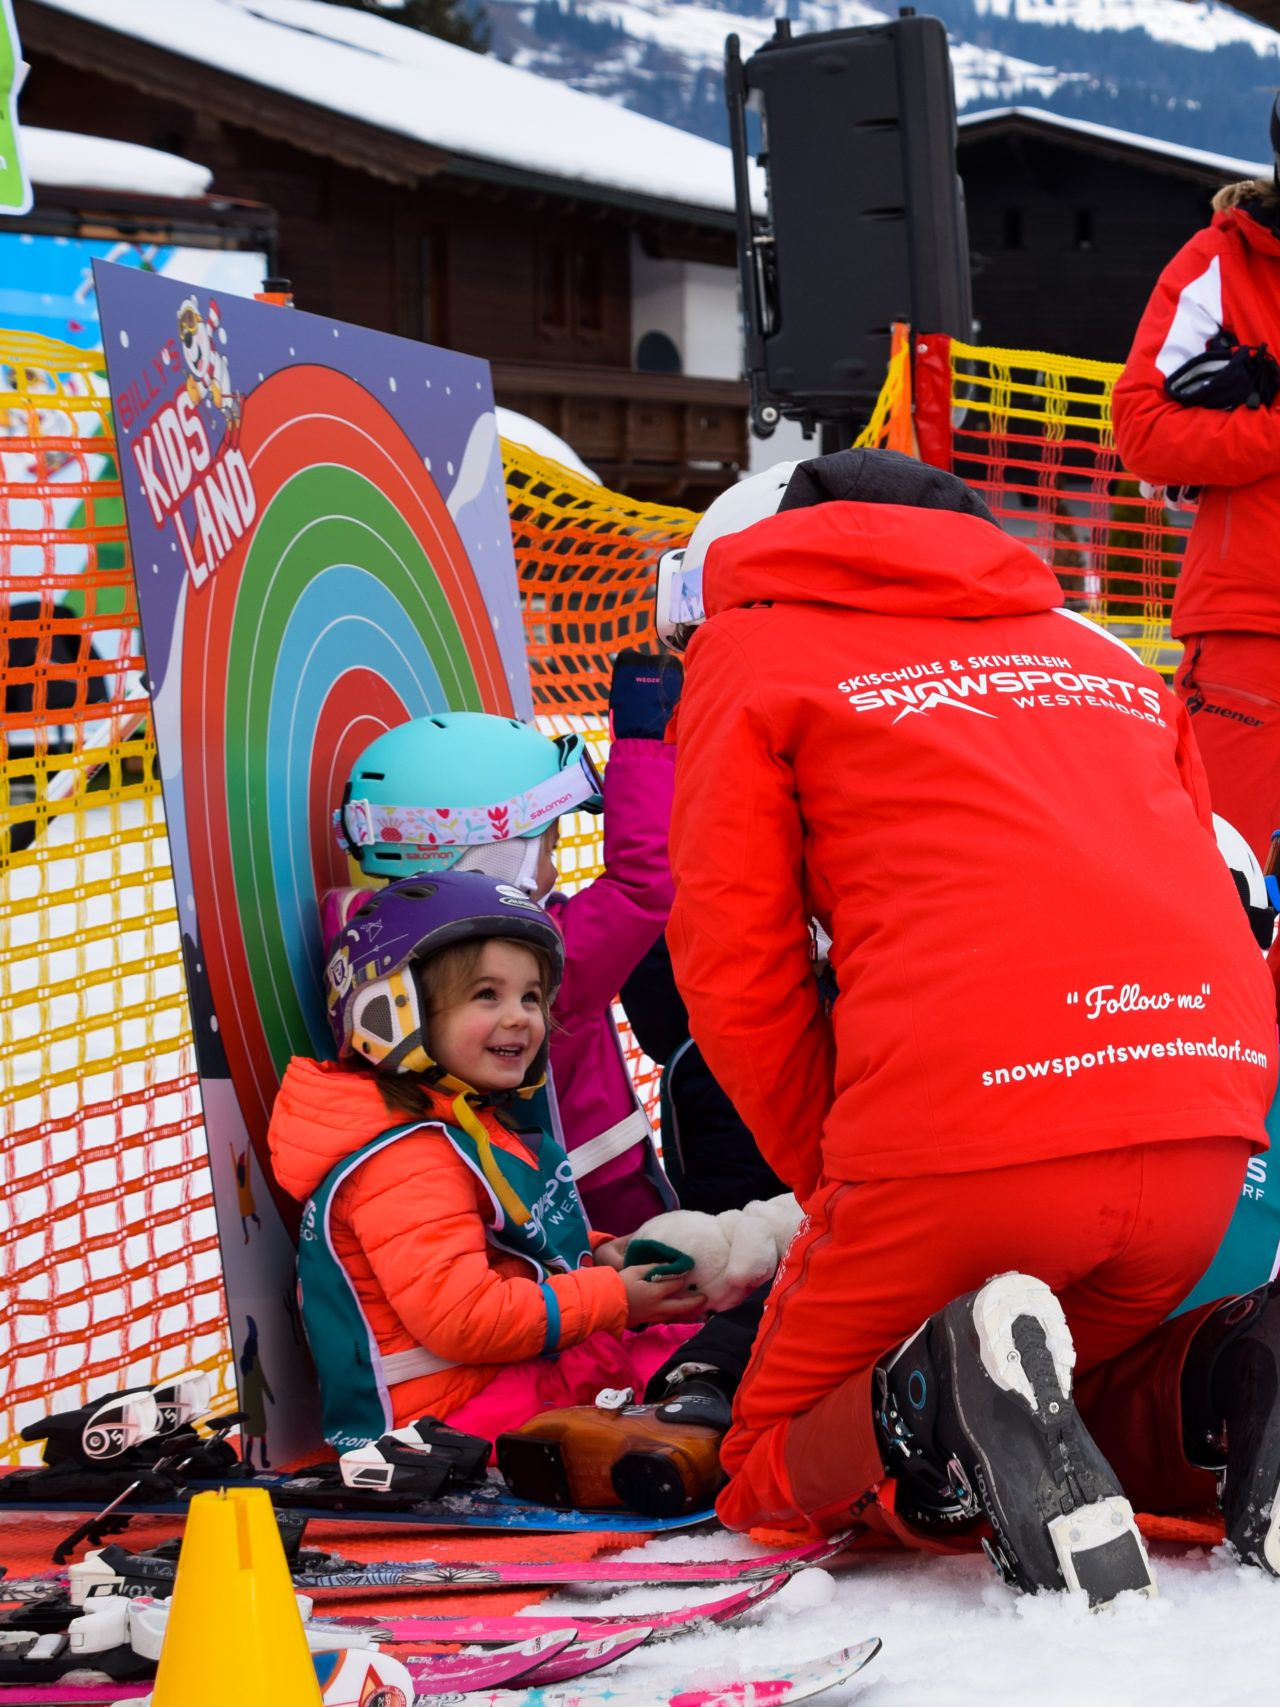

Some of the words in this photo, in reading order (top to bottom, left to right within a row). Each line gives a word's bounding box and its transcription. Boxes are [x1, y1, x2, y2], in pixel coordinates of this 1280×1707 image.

[133, 385, 211, 524] KIDS
[173, 448, 257, 591] LAND
[837, 660, 944, 694] SKISCHULE
[949, 657, 965, 672] &
[967, 653, 1072, 670] SKIVERLEIH
[849, 670, 1161, 714] SNOWSPORTS
[1203, 704, 1265, 728] ziener
[981, 1036, 1268, 1086] snowsportswestendorf.com
